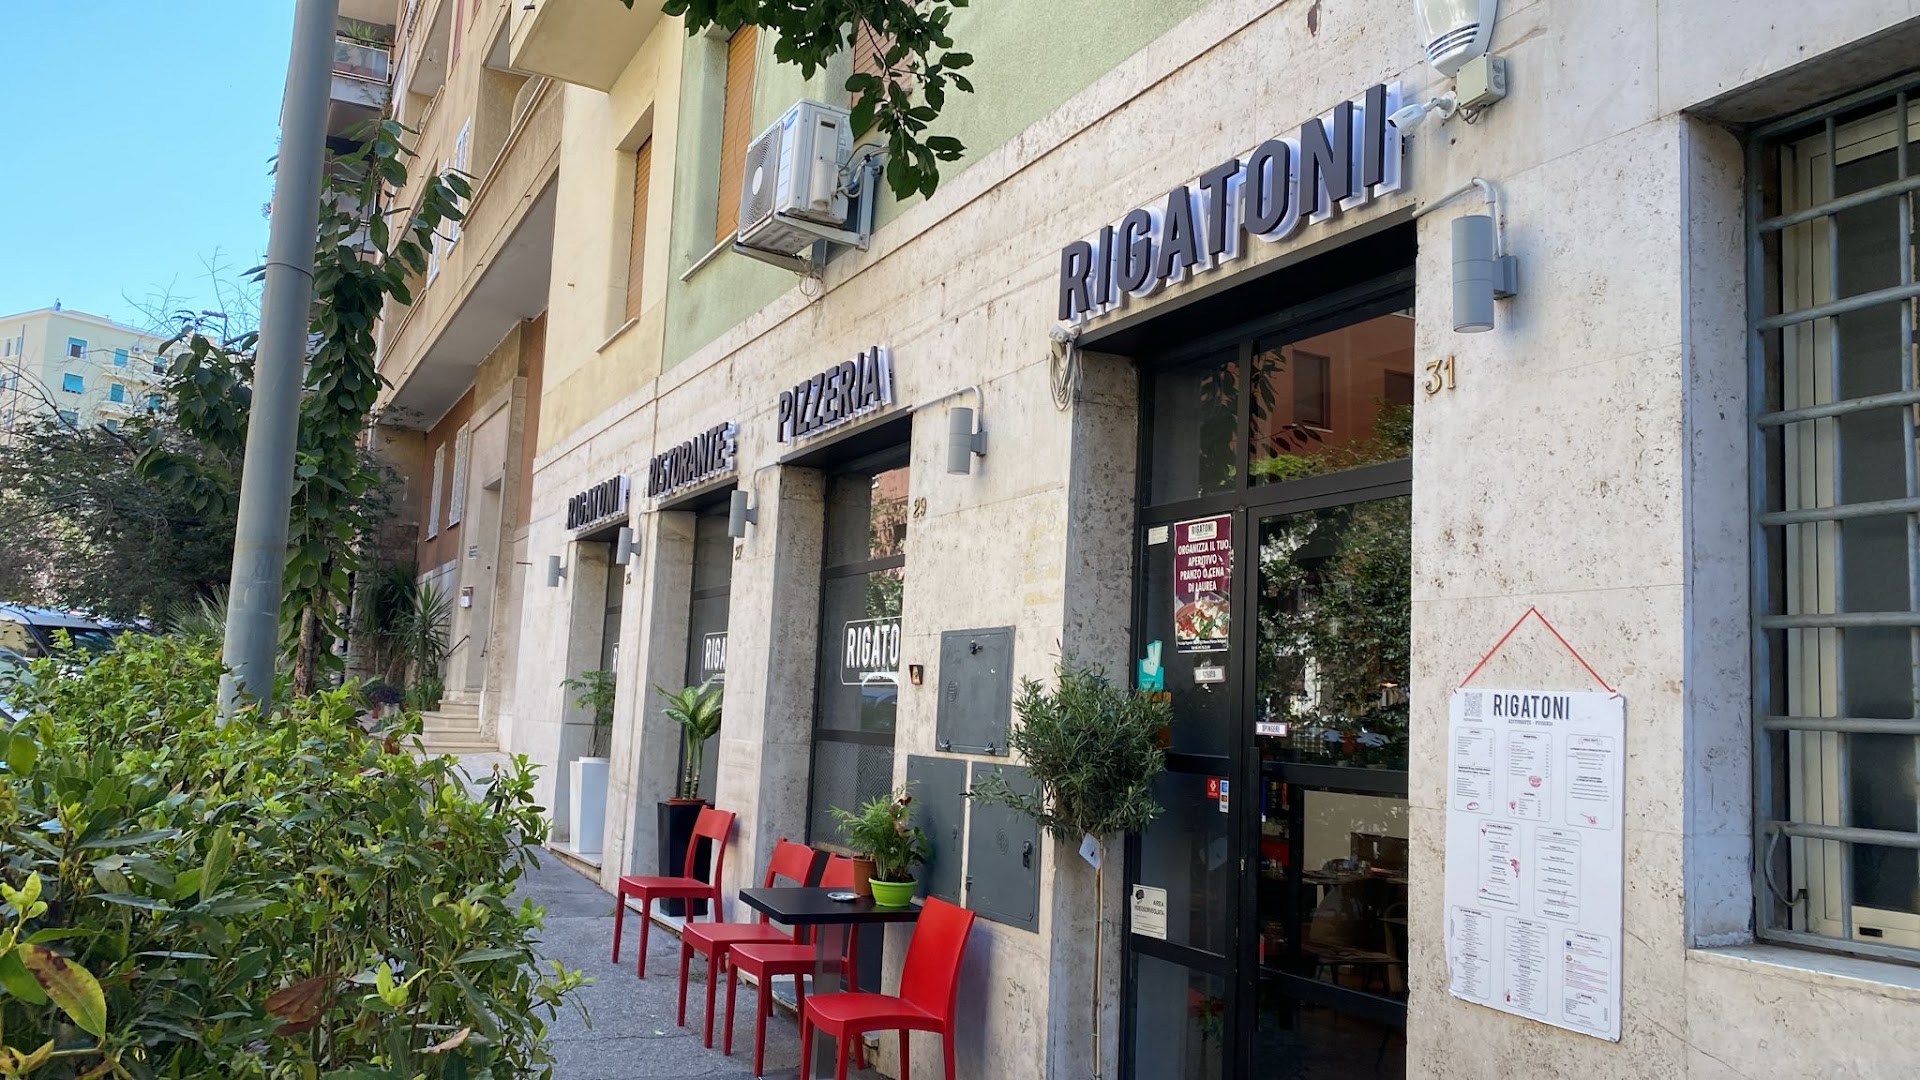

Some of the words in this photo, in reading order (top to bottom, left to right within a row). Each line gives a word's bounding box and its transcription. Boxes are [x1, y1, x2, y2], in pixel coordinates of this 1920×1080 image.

[1058, 83, 1388, 321] RIGATONI
[1425, 355, 1456, 395] 31
[777, 346, 881, 443] PIZZERIA
[648, 422, 729, 497] RISTORANTE
[567, 475, 621, 530] RIGATONI
[913, 497, 927, 518] 29
[1191, 522, 1214, 534] RIGATONI
[735, 544, 743, 560] 27
[1178, 542, 1209, 555] ORGANIZZA
[1210, 541, 1215, 551] IL
[1217, 539, 1229, 550] TUO
[1188, 554, 1217, 567] APERITIVO
[1180, 569, 1201, 580] PRANZO
[1209, 567, 1224, 578] CENA
[1188, 582, 1194, 593] DI
[1196, 580, 1217, 592] LAUREA
[705, 637, 726, 670] RIGA
[846, 624, 900, 669] RIGATO
[1493, 693, 1570, 720] RIGATONI
